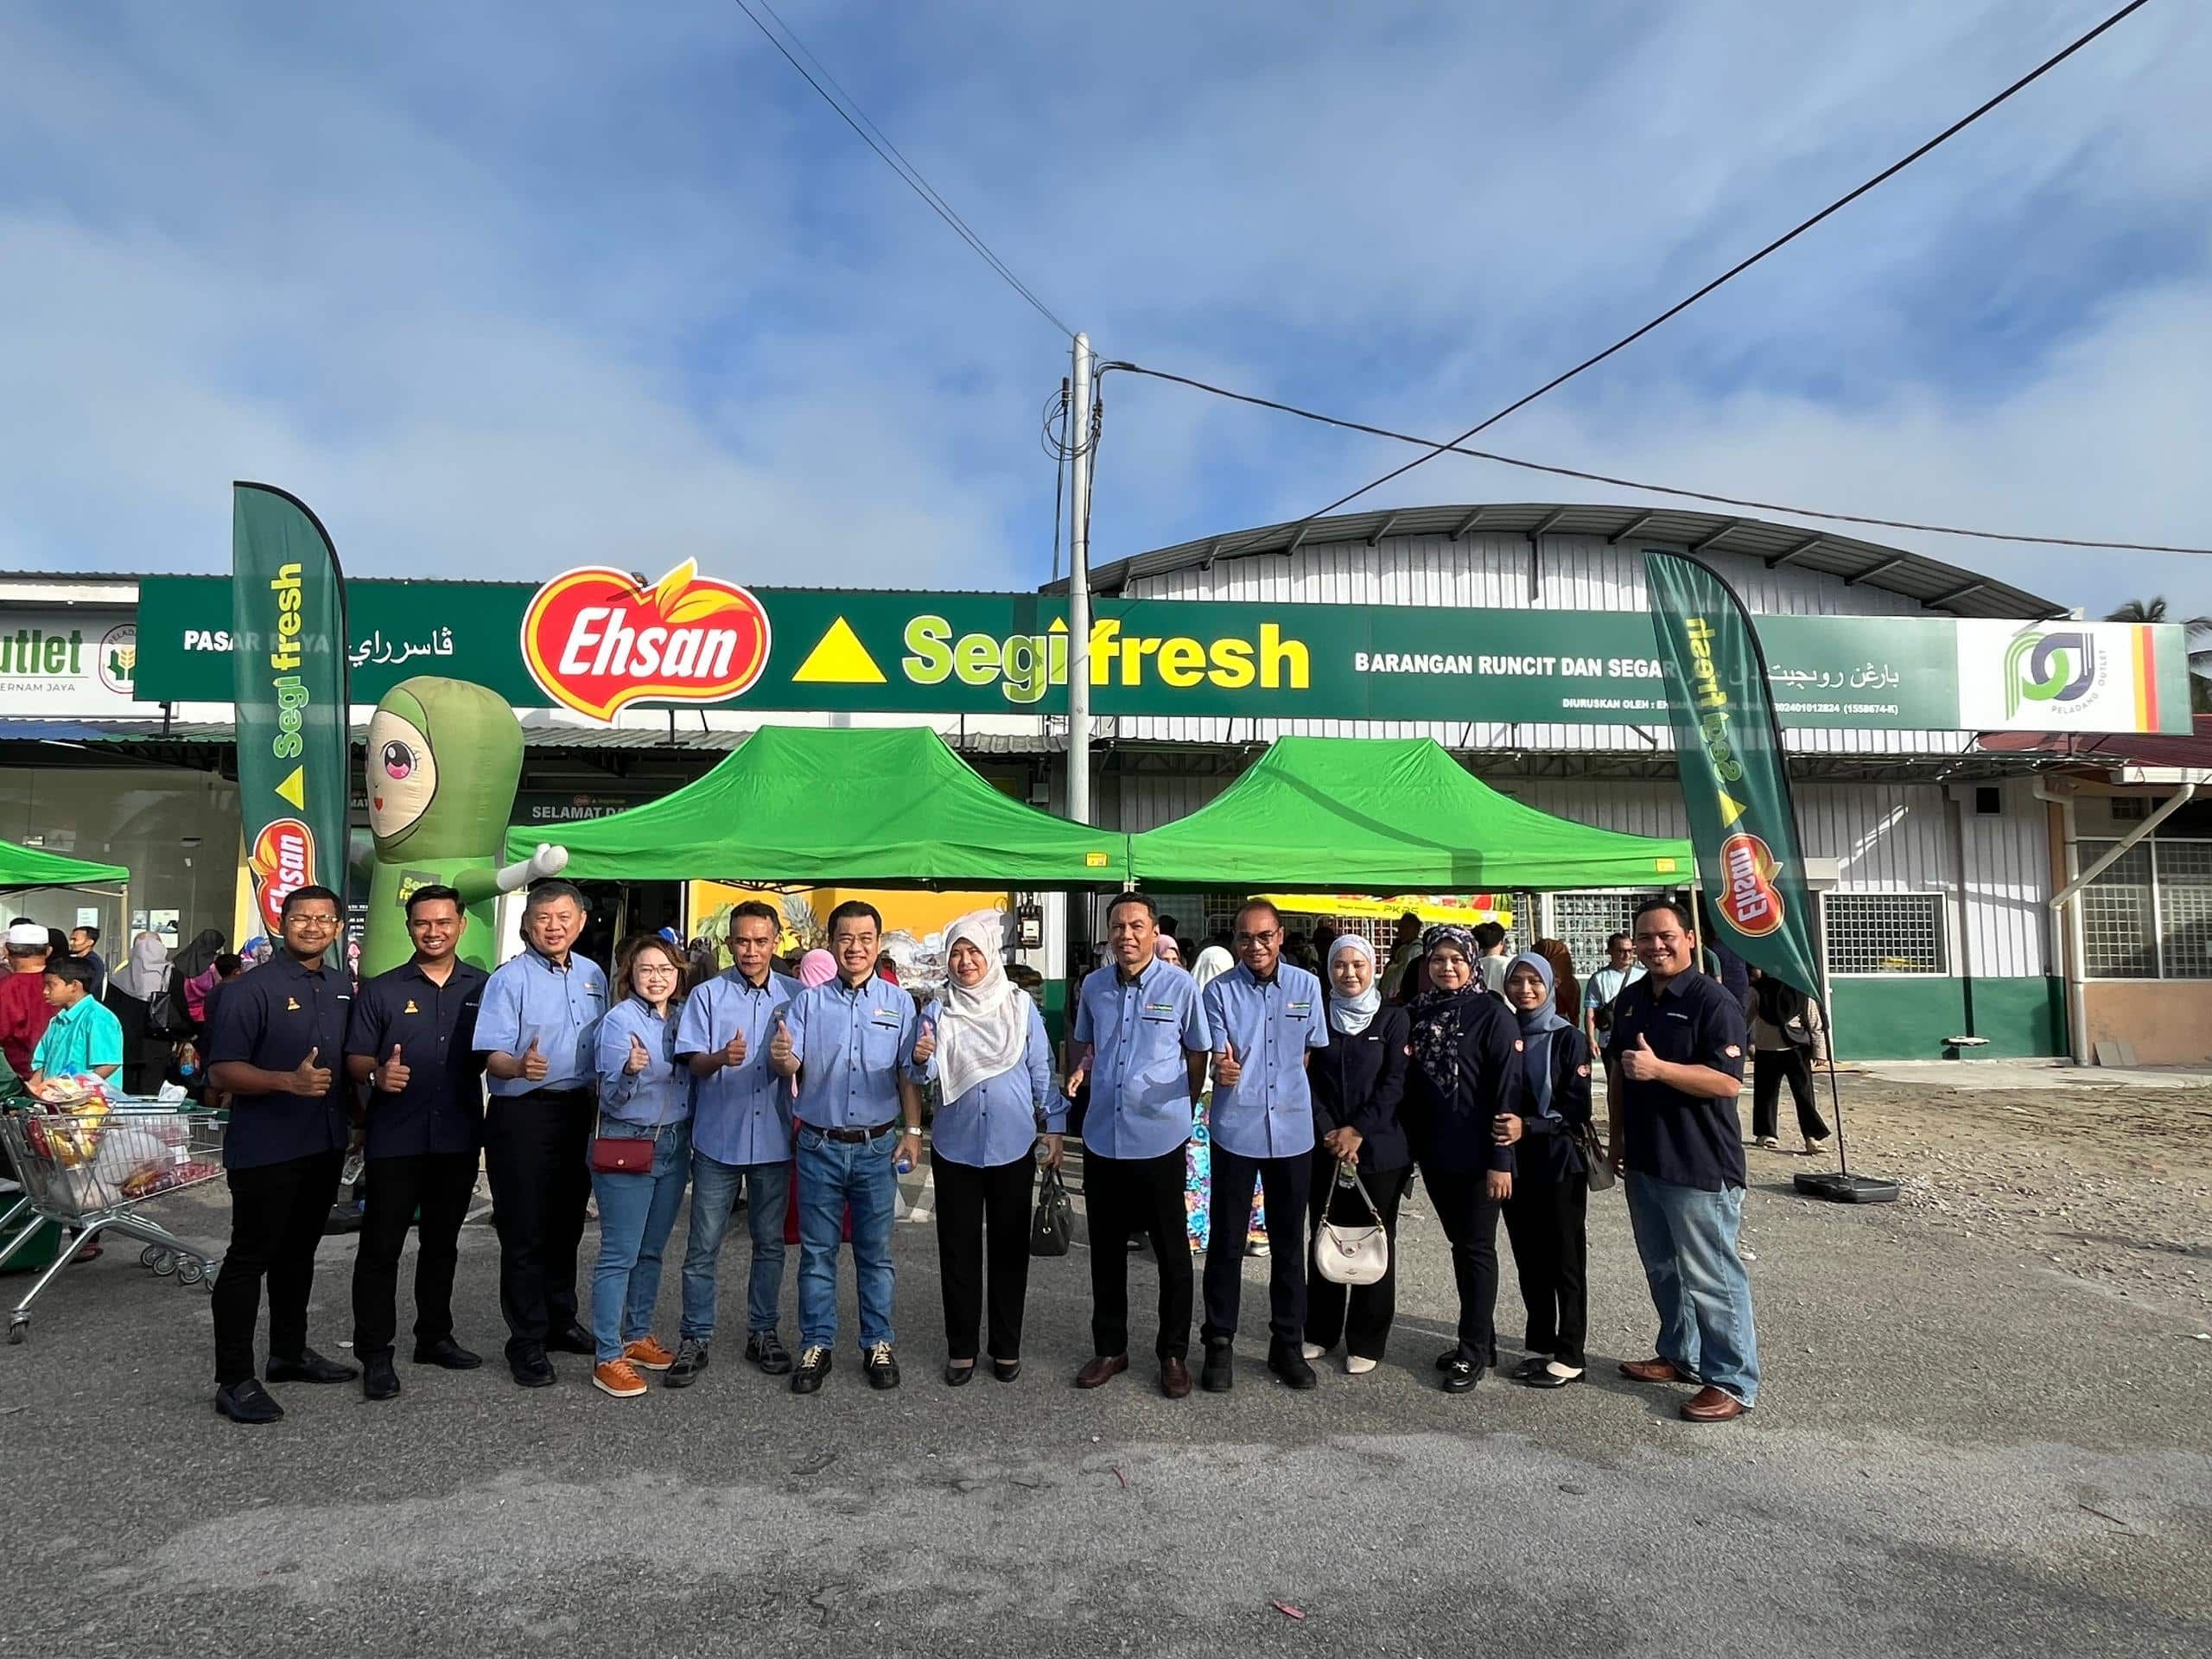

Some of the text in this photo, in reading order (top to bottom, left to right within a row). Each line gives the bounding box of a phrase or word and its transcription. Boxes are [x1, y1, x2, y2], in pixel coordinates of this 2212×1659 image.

[270, 563, 302, 671] fresh
[558, 607, 738, 678] Ehsan
[901, 614, 1310, 703] Segi fresh
[1355, 652, 1472, 674] BARANGAN
[1478, 655, 1556, 676] RUNCIT
[1561, 658, 1603, 677] DAN
[47, 683, 75, 691] JAYA
[1562, 697, 1620, 709] DIURUSKAN
[1623, 699, 1649, 709] OLEH
[532, 805, 602, 819] SELAMAT
